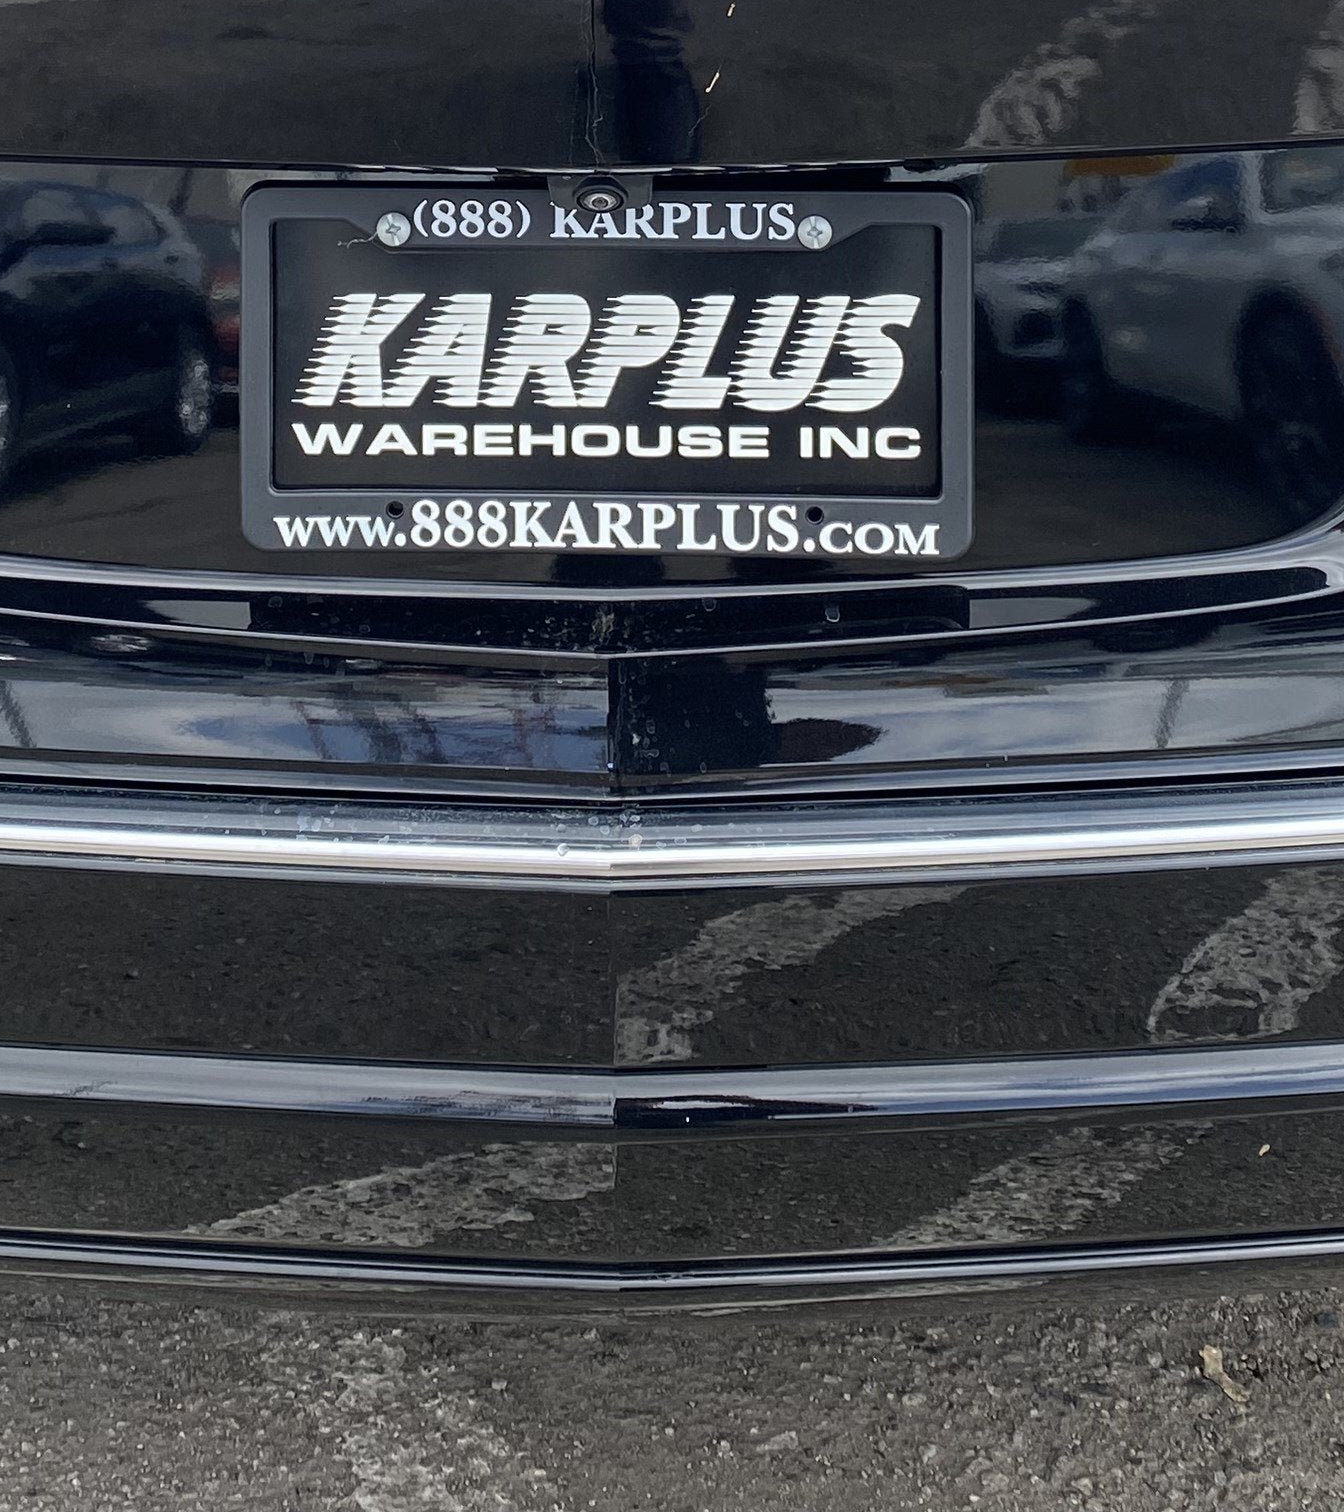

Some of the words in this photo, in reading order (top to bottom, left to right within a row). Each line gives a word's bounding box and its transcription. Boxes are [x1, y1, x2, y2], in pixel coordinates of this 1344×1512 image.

[412, 199, 532, 240] (888)
[549, 201, 796, 242] KARPLUS
[291, 293, 921, 413] KARPLUS
[291, 423, 769, 460] WAREHOUSE
[799, 426, 921, 460] INC
